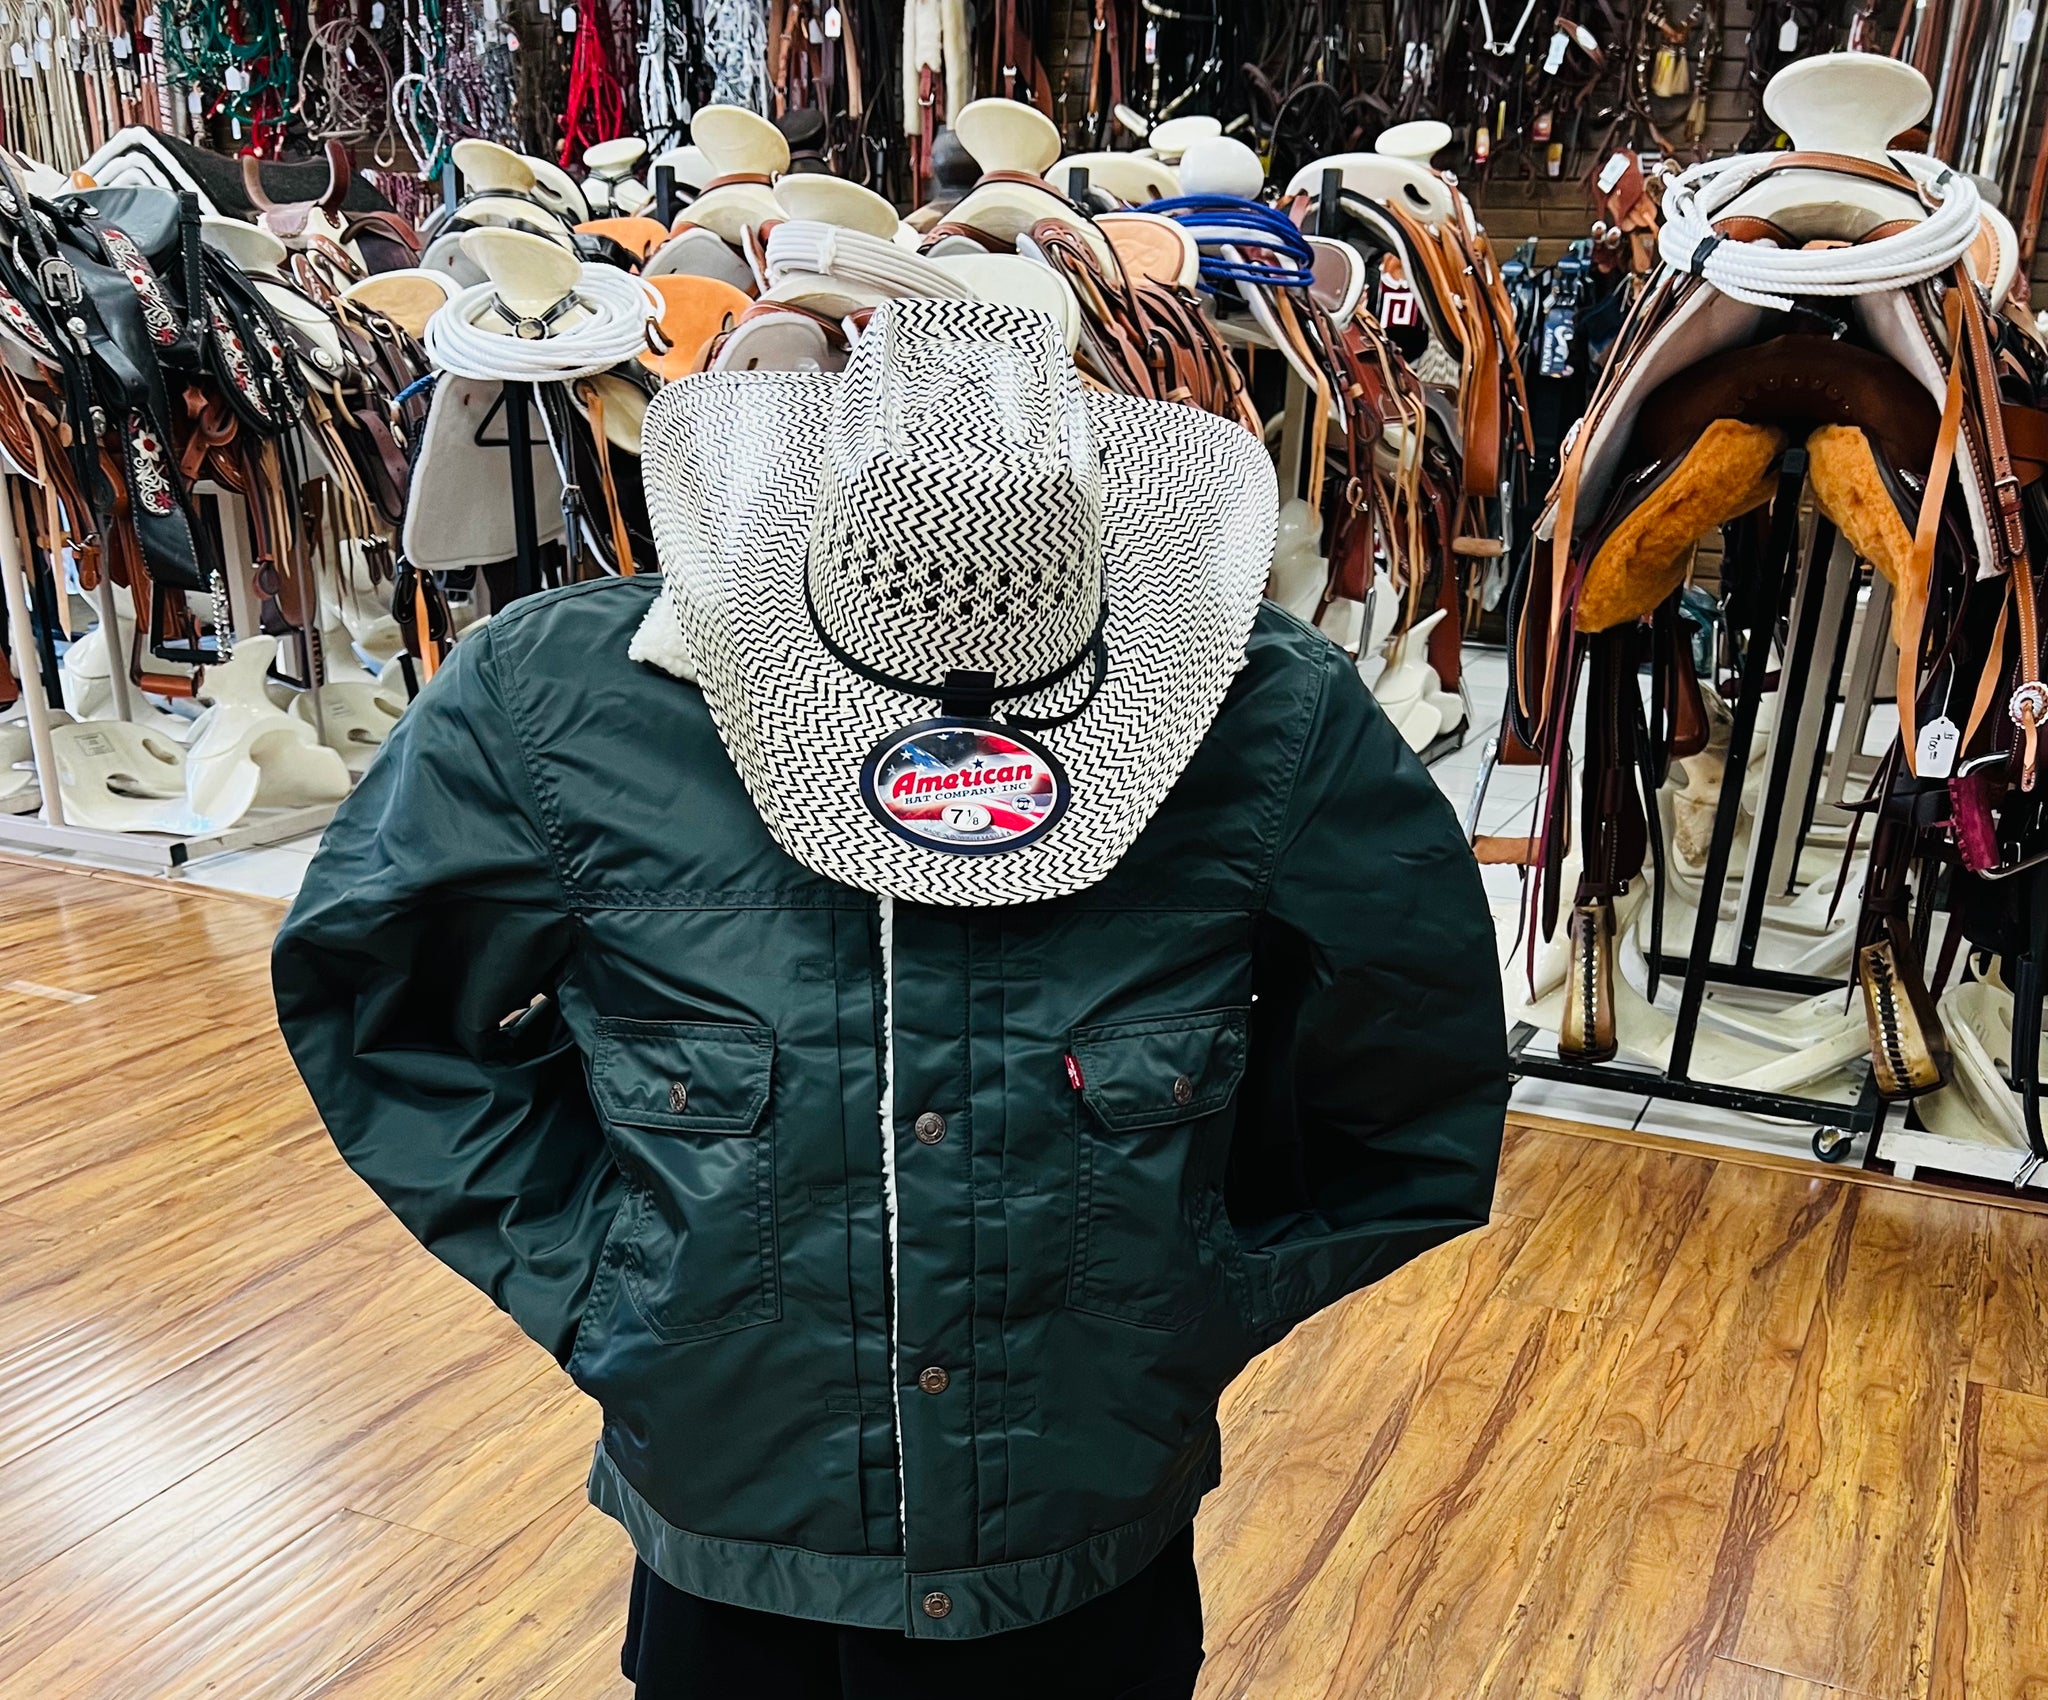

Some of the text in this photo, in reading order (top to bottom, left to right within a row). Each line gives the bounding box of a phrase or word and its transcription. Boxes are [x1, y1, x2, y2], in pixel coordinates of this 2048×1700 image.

[892, 764, 1033, 799] American
[905, 782, 1027, 805] HAT COMPANY INC
[951, 808, 963, 824] 7
